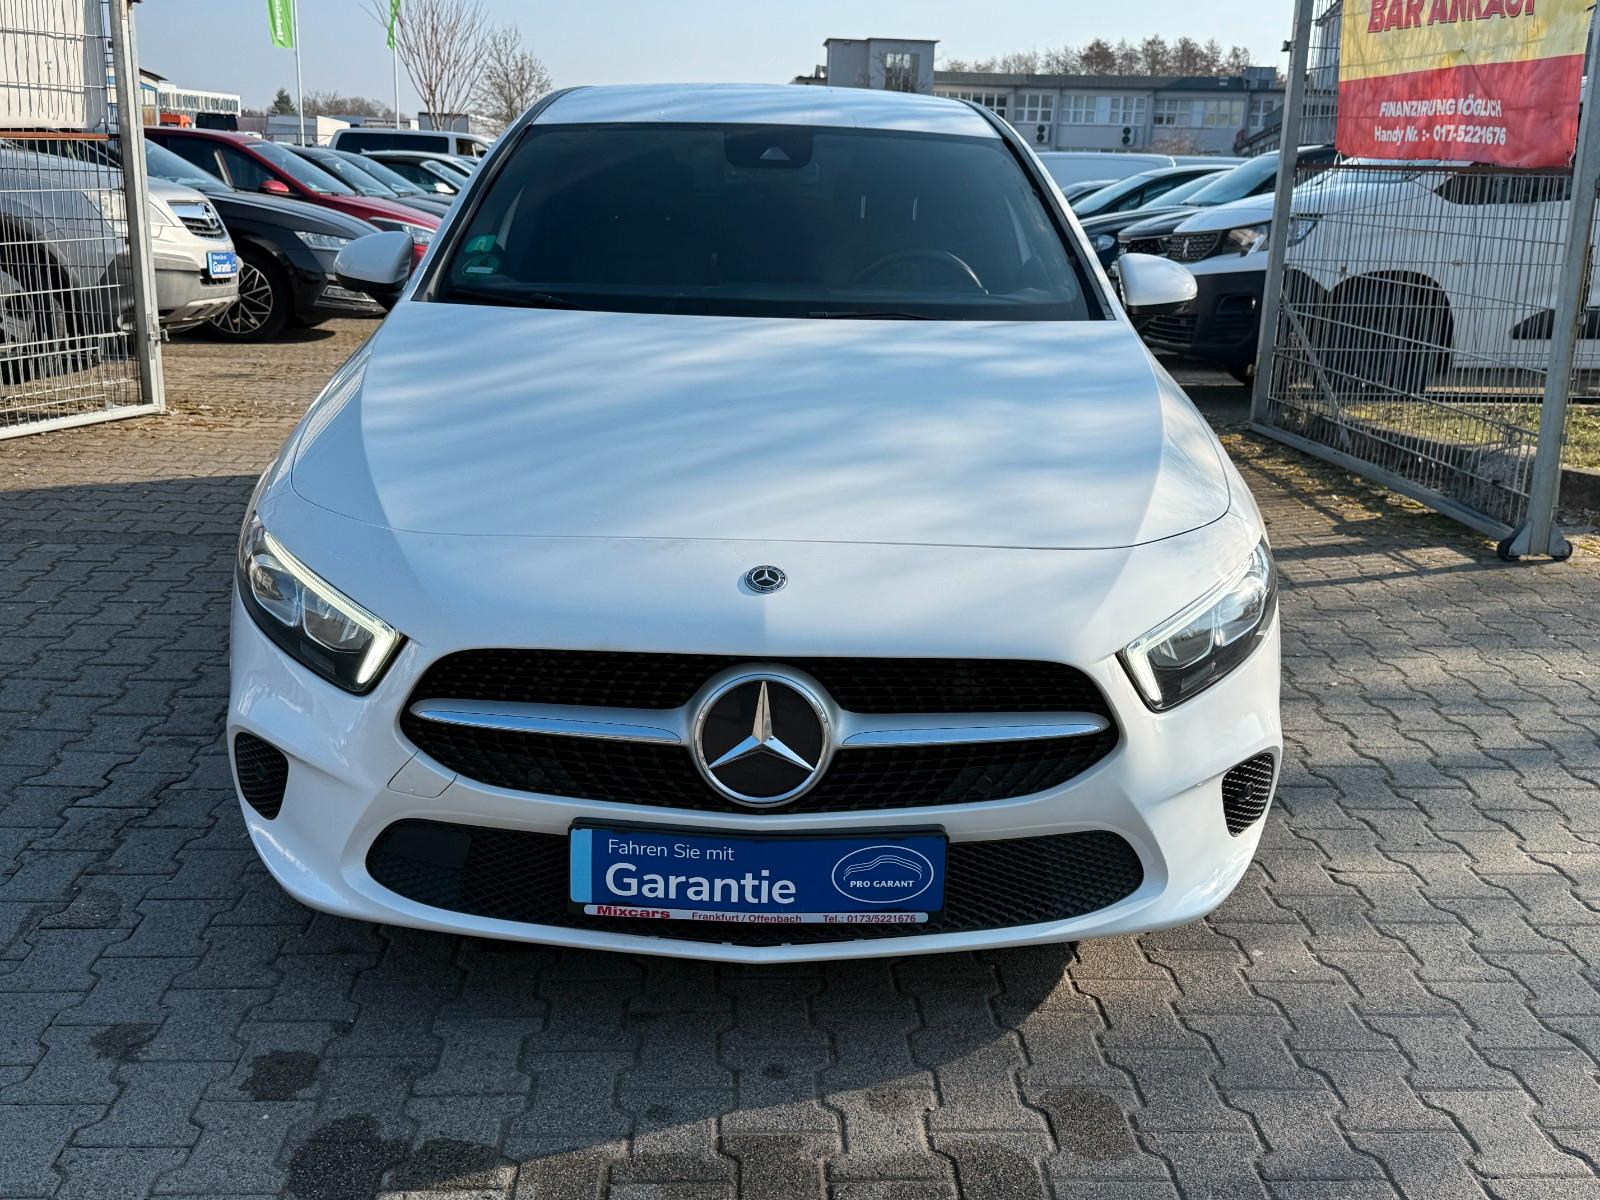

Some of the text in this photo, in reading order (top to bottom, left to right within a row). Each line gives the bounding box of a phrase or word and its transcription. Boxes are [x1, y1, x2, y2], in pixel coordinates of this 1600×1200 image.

[1367, 0, 1424, 33] BAR
[1374, 126, 1404, 146] Handy
[1405, 126, 1419, 143] Nr.
[608, 839, 735, 861] Fahren Sie mit
[605, 862, 797, 905] Garantie
[850, 880, 915, 888] PRO GARANT
[596, 905, 671, 919] Mixcars
[691, 911, 740, 922] Frankfurt
[748, 913, 802, 924] Offenbach
[823, 914, 844, 923] Tel.:
[847, 914, 917, 924] 0173/5221676
